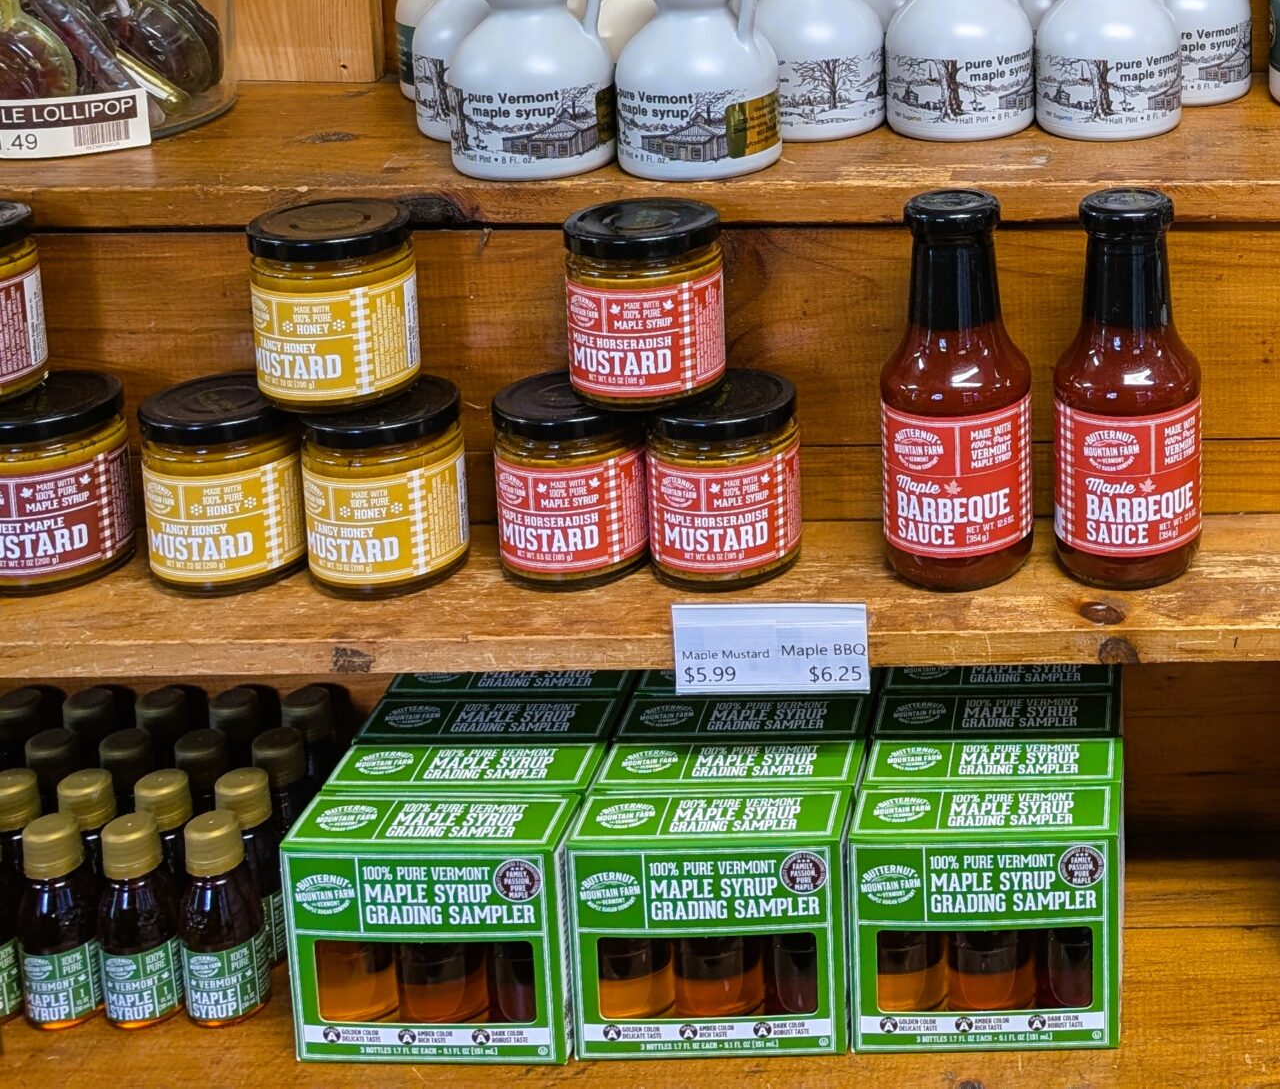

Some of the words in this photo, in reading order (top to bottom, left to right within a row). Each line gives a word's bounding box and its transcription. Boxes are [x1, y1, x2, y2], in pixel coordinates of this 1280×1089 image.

[468, 93, 494, 106] pure
[497, 90, 559, 104] Vermont
[32, 98, 133, 122] LOLLIPOP
[472, 106, 510, 120] maple
[516, 106, 556, 120] syrup
[896, 475, 941, 494] Maple
[897, 488, 1010, 524] BARBEQUE
[664, 512, 692, 528] MAPLE
[694, 509, 768, 528] HORSERADISH
[160, 523, 190, 535] TANGY
[191, 524, 227, 535] HONEY
[664, 520, 768, 552] MUSTARD
[898, 518, 955, 545] SAUCE
[150, 531, 253, 559] MUSTARD
[682, 650, 718, 662] Maple
[722, 649, 769, 659] Mustard
[781, 644, 827, 659] Maple
[834, 643, 866, 657] BBQ
[684, 666, 736, 684] $5.99
[809, 665, 862, 683] $6.25
[648, 862, 679, 877] 100%
[682, 861, 714, 876] PURE
[717, 860, 777, 875] VERMONT
[650, 879, 711, 899] MAPLE
[721, 877, 778, 898] SYRUP
[650, 900, 728, 921] GRADING
[734, 897, 820, 919] SAMPLER
[199, 973, 243, 990] VERMONT
[190, 988, 236, 1006] MAPLE
[192, 1001, 237, 1019] SYRUP
